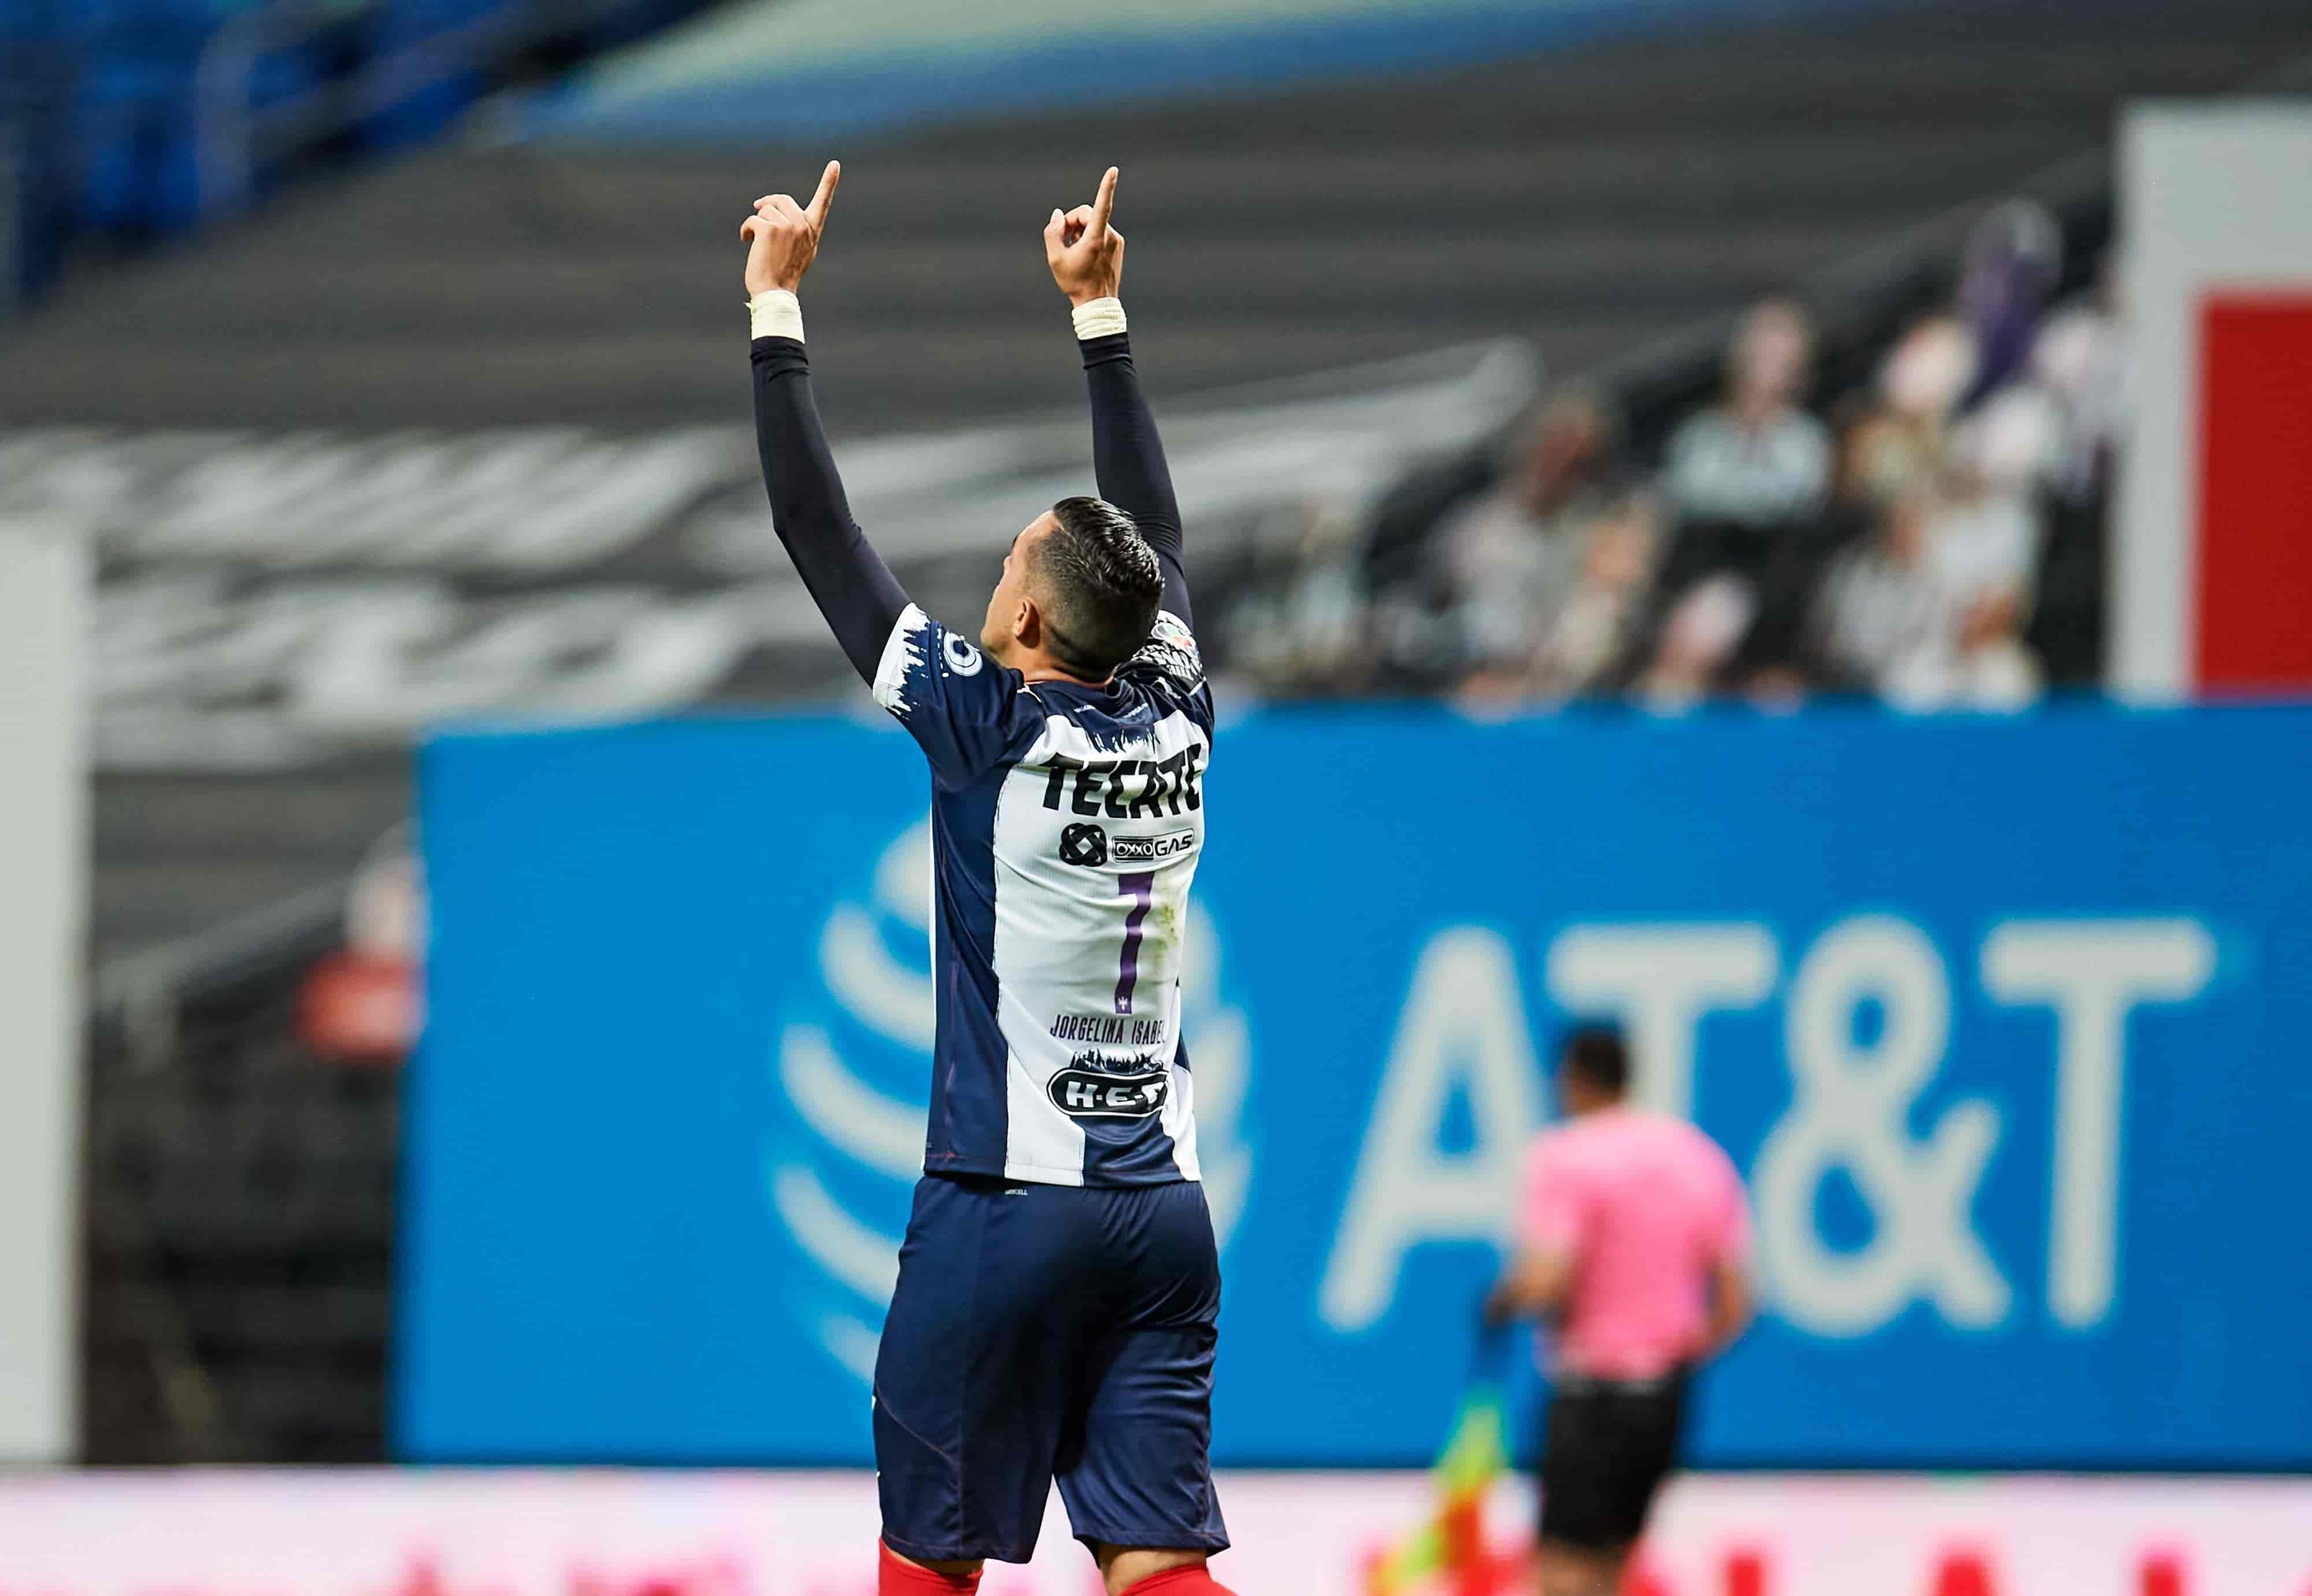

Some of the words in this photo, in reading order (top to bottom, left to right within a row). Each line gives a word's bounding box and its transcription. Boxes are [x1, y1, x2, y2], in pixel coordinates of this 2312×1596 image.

[1039, 743, 1202, 818] TECATE
[1115, 871, 1155, 1014] 7
[1050, 1014, 1124, 1044] JORGELINA
[1321, 914, 2215, 1334] AT&T
